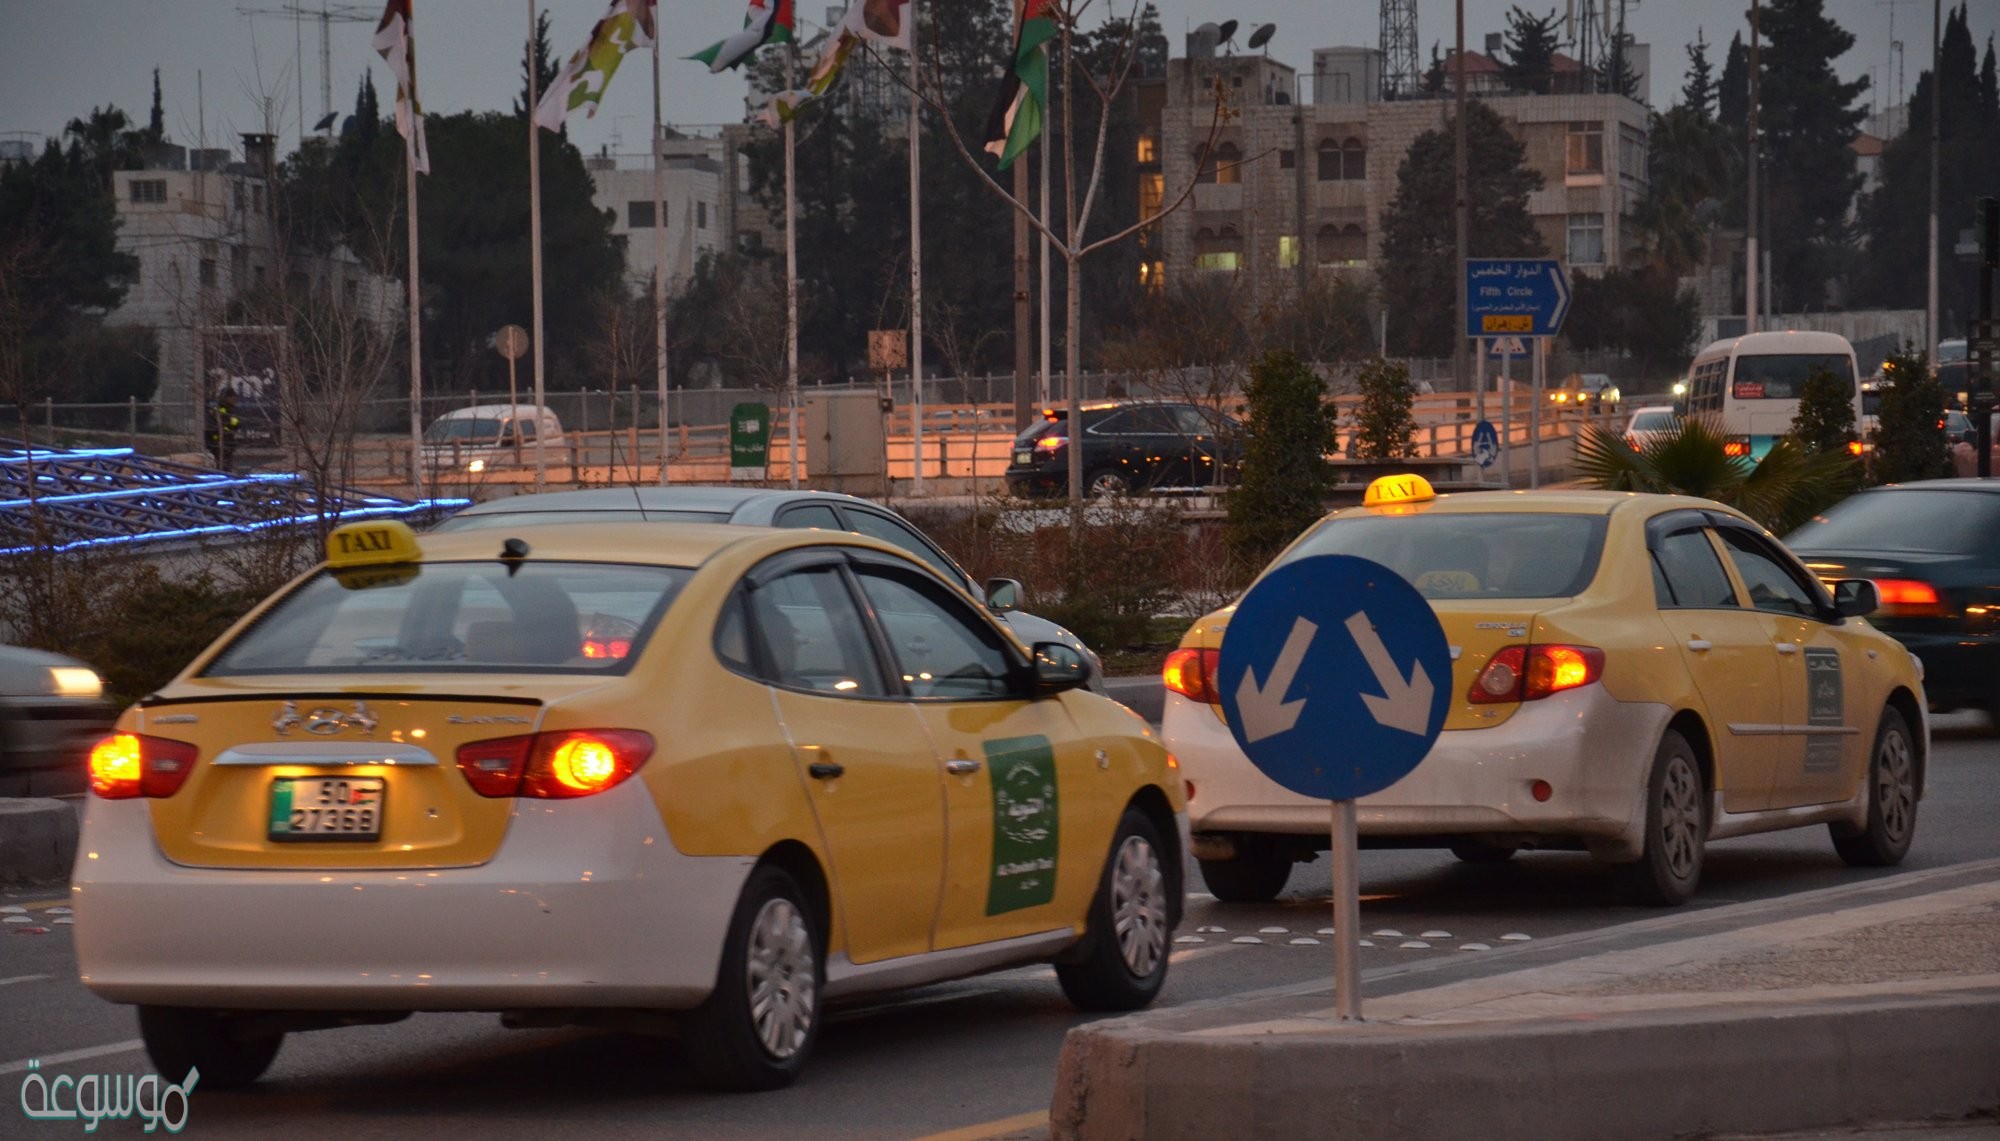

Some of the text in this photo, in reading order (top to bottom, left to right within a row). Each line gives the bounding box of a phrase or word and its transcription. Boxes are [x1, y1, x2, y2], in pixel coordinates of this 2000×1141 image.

[1471, 263, 1542, 280] الدوار الخامس
[1480, 286, 1534, 297] Fifth Circle
[1374, 481, 1417, 500] TAXI
[336, 529, 393, 553] TAXI
[320, 781, 349, 805] 50
